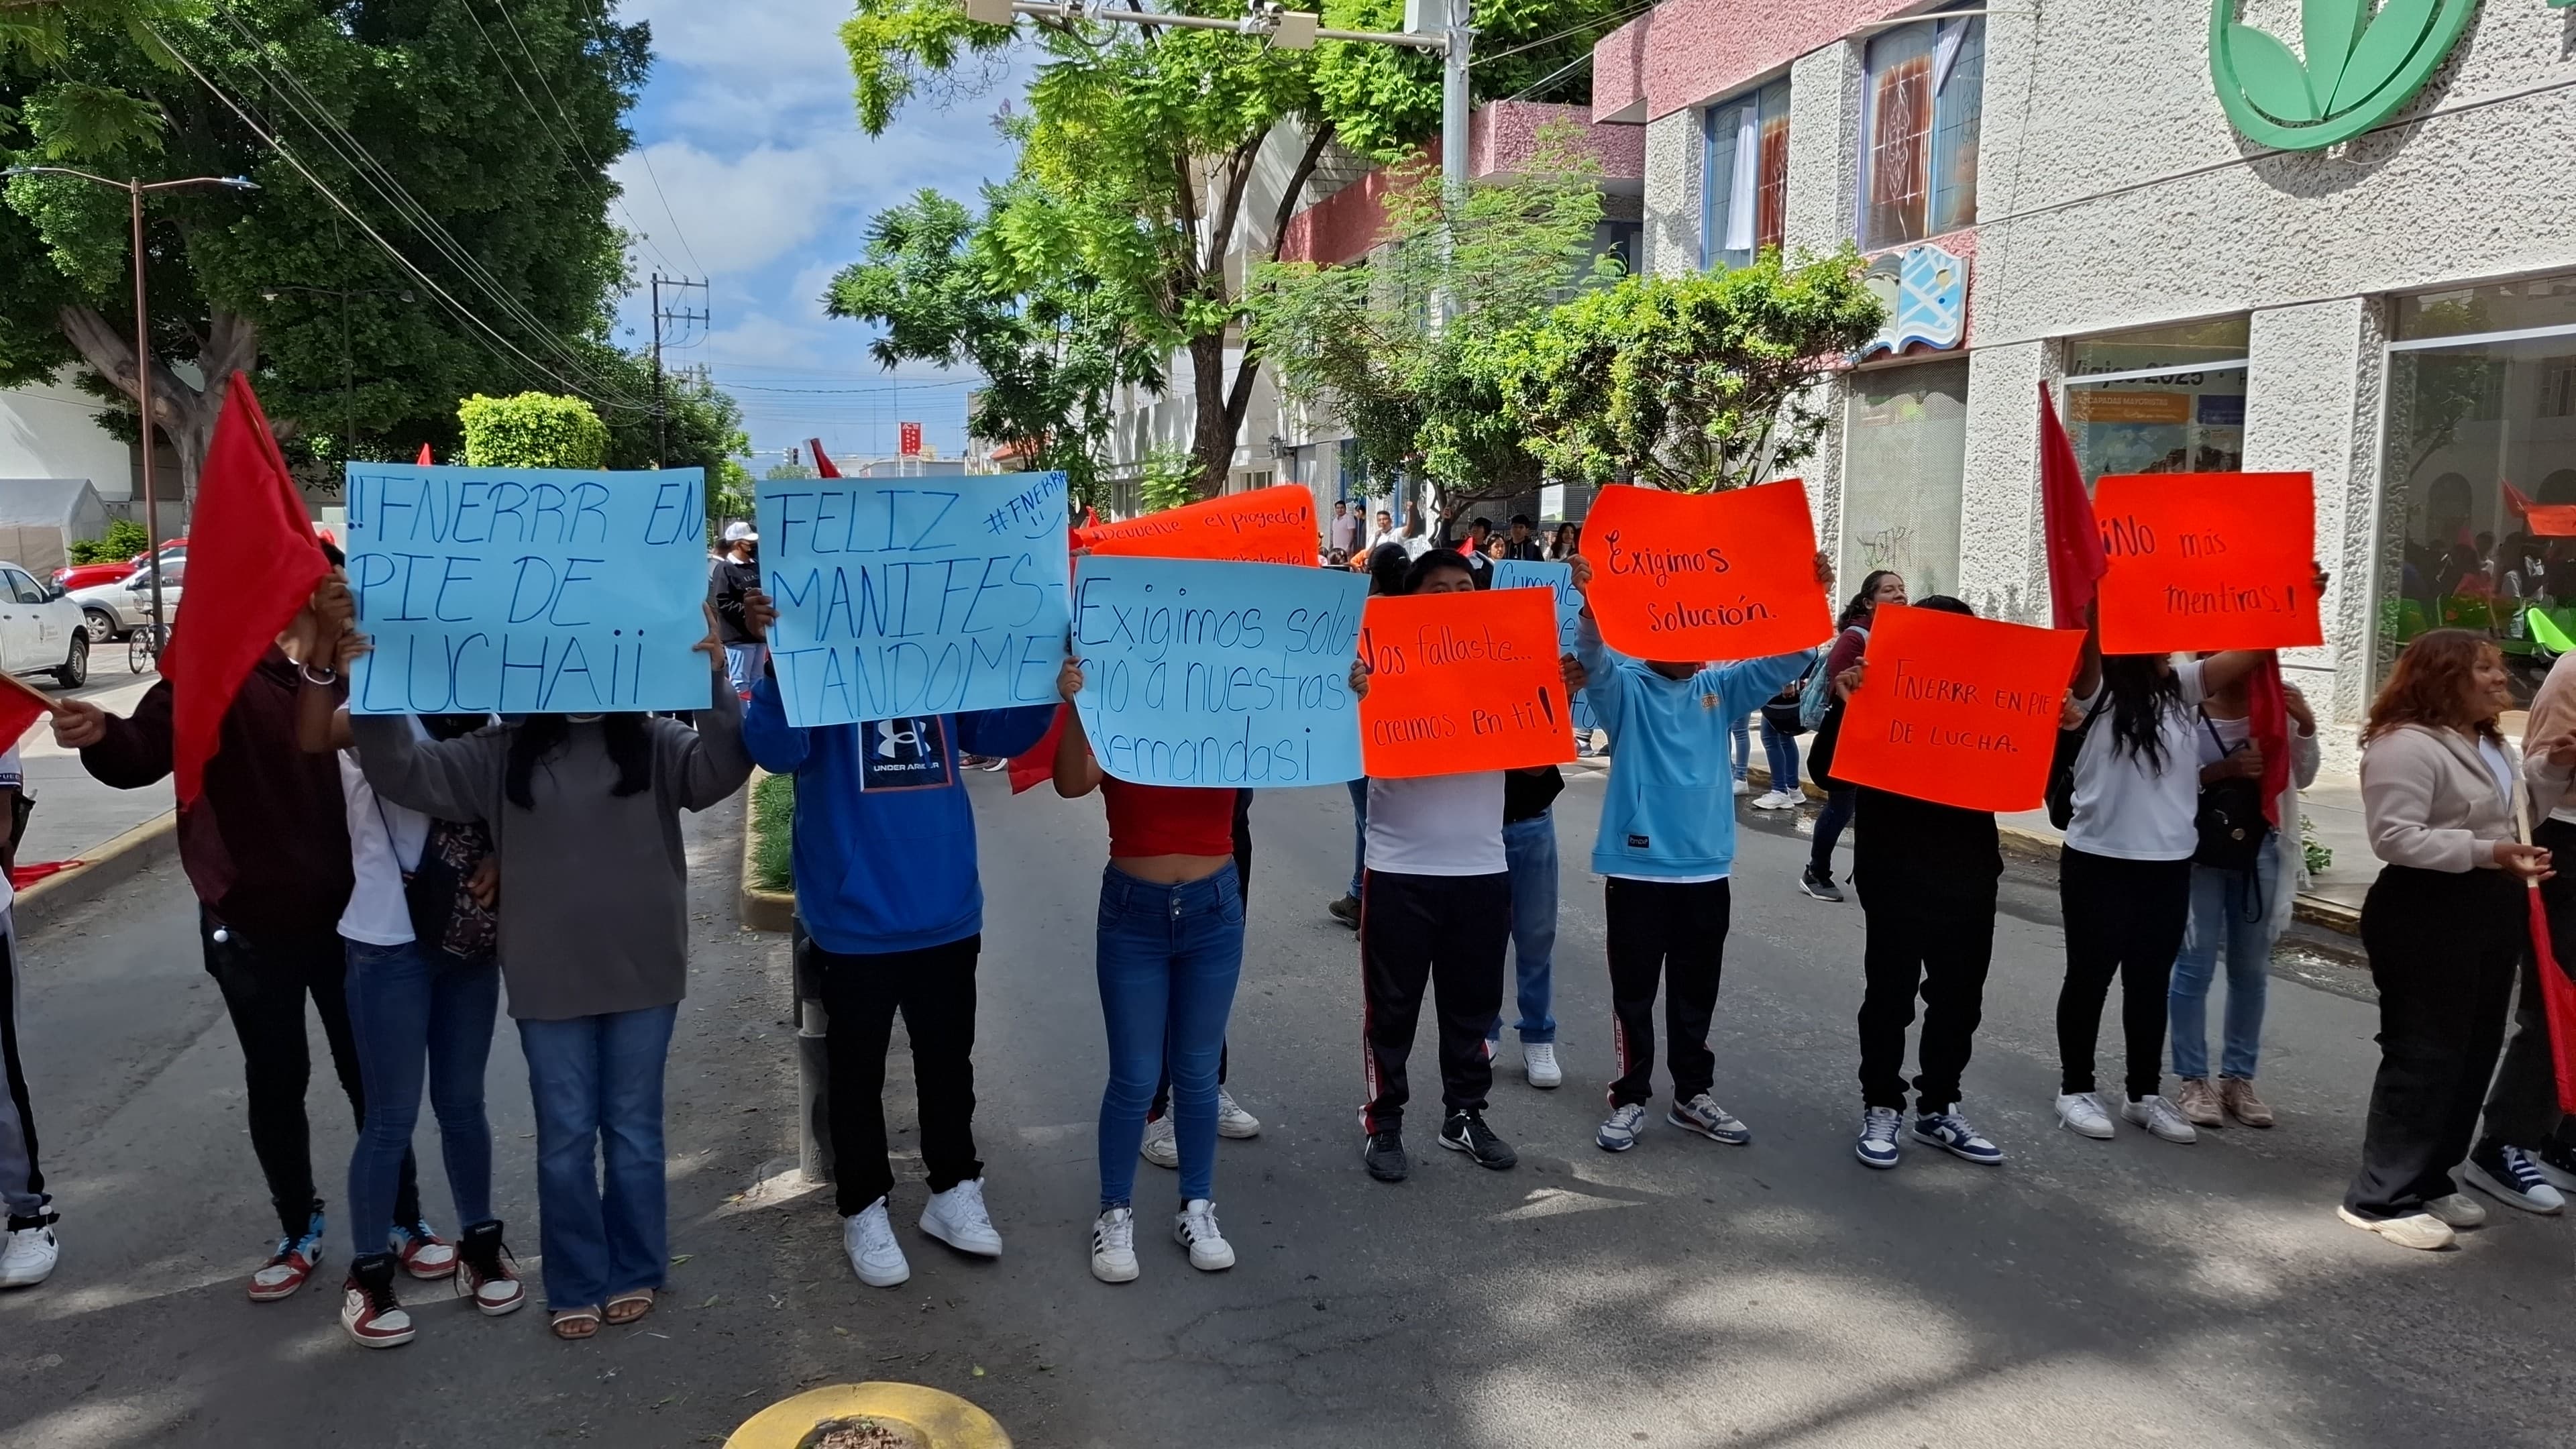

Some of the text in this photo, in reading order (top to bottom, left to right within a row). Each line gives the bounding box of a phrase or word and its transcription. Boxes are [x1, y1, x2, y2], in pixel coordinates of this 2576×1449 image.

[645, 478, 704, 545] EN
[764, 490, 959, 557] FELIZ
[1204, 513, 1225, 527] el
[1605, 529, 1729, 588] Exigimos
[2178, 529, 2227, 559] más
[352, 553, 605, 627] PIE DE
[1415, 623, 1533, 672] fallaste...
[771, 633, 1058, 727] TANDOME
[1185, 651, 1347, 713] nuestras
[1893, 658, 2052, 716] FNERRR EN PIE
[1472, 708, 1503, 736] en
[1888, 718, 1915, 744] DE
